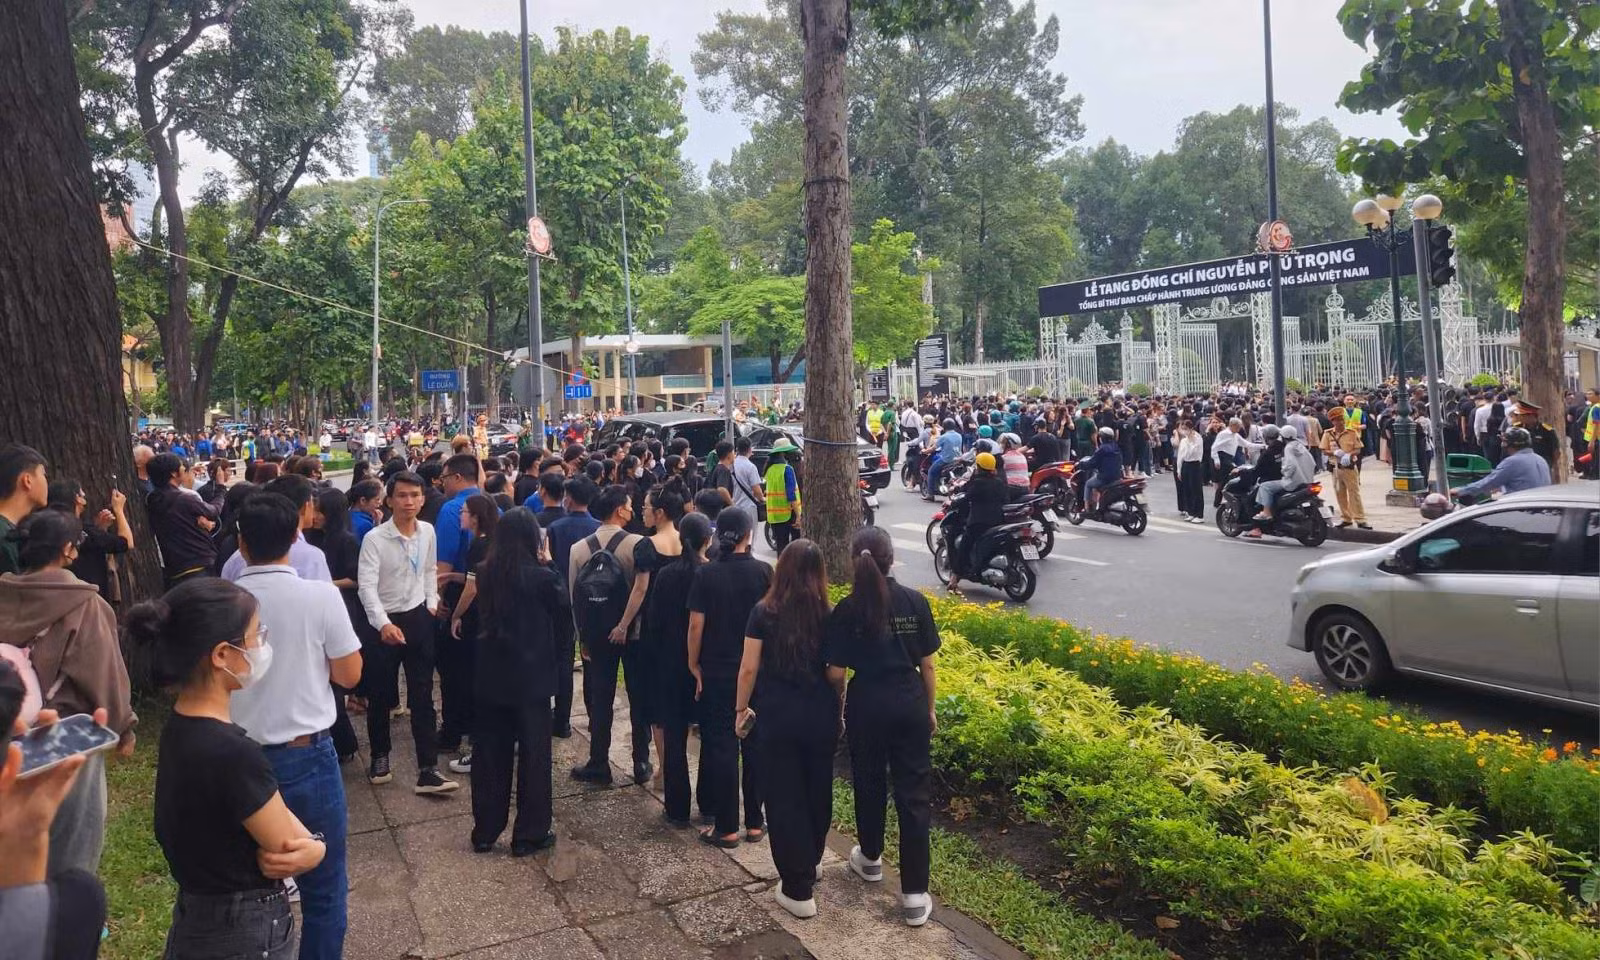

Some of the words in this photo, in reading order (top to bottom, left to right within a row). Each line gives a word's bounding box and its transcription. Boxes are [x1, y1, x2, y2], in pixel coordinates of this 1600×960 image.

[1085, 281, 1098, 297] LỄ
[1099, 280, 1130, 295] TANG
[1170, 269, 1194, 285] CHÍ
[1196, 259, 1256, 282] NGUYỄN
[1259, 254, 1292, 274] PÚ
[1294, 247, 1355, 269] TRỌNG
[1098, 298, 1105, 308] BÍ
[1106, 297, 1121, 306] THƯ
[1121, 296, 1136, 305] BAN
[1137, 291, 1157, 303] CHẤP
[1158, 290, 1181, 300] HÀNH
[1182, 286, 1210, 298] TRUNG
[1211, 283, 1237, 293] ƯƠNG
[1238, 279, 1265, 291] ĐẢNG
[1267, 275, 1295, 288] CNG
[1296, 271, 1317, 284] SẢN
[1318, 269, 1341, 282] VIỆT
[1343, 266, 1369, 278] NAM
